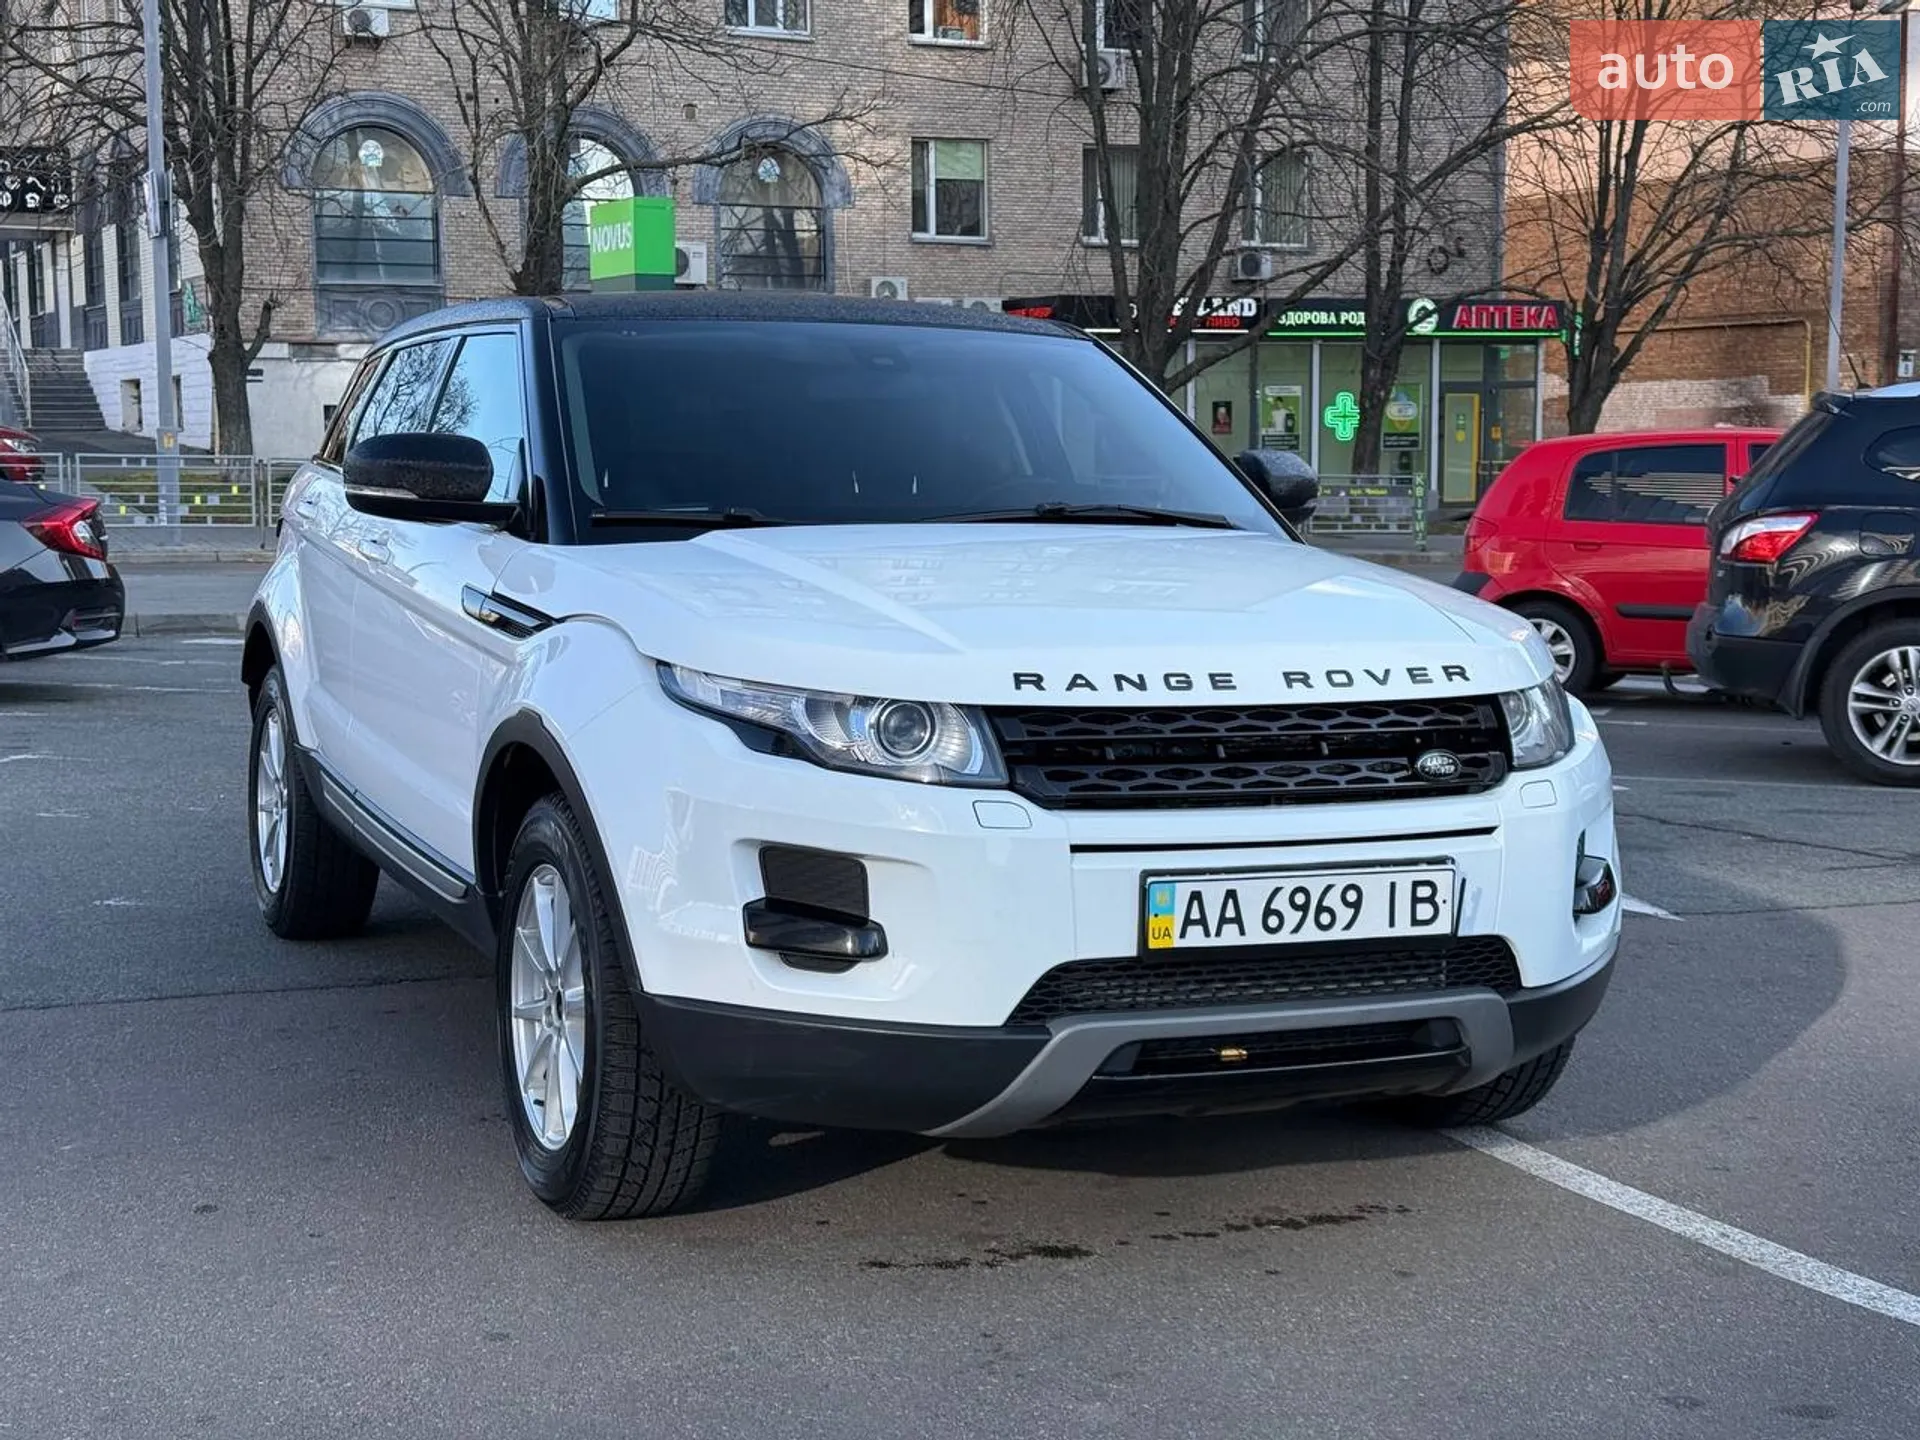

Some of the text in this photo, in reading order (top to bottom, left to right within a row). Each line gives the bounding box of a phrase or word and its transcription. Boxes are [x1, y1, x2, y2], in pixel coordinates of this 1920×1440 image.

[592, 221, 632, 253] NOVUS
[1340, 311, 1366, 326] РОД
[1452, 305, 1558, 328] АПТЕКА
[1014, 664, 1472, 692] RANGE ROVER
[1179, 879, 1440, 939] AA 6969 IB
[1151, 926, 1172, 941] UA
